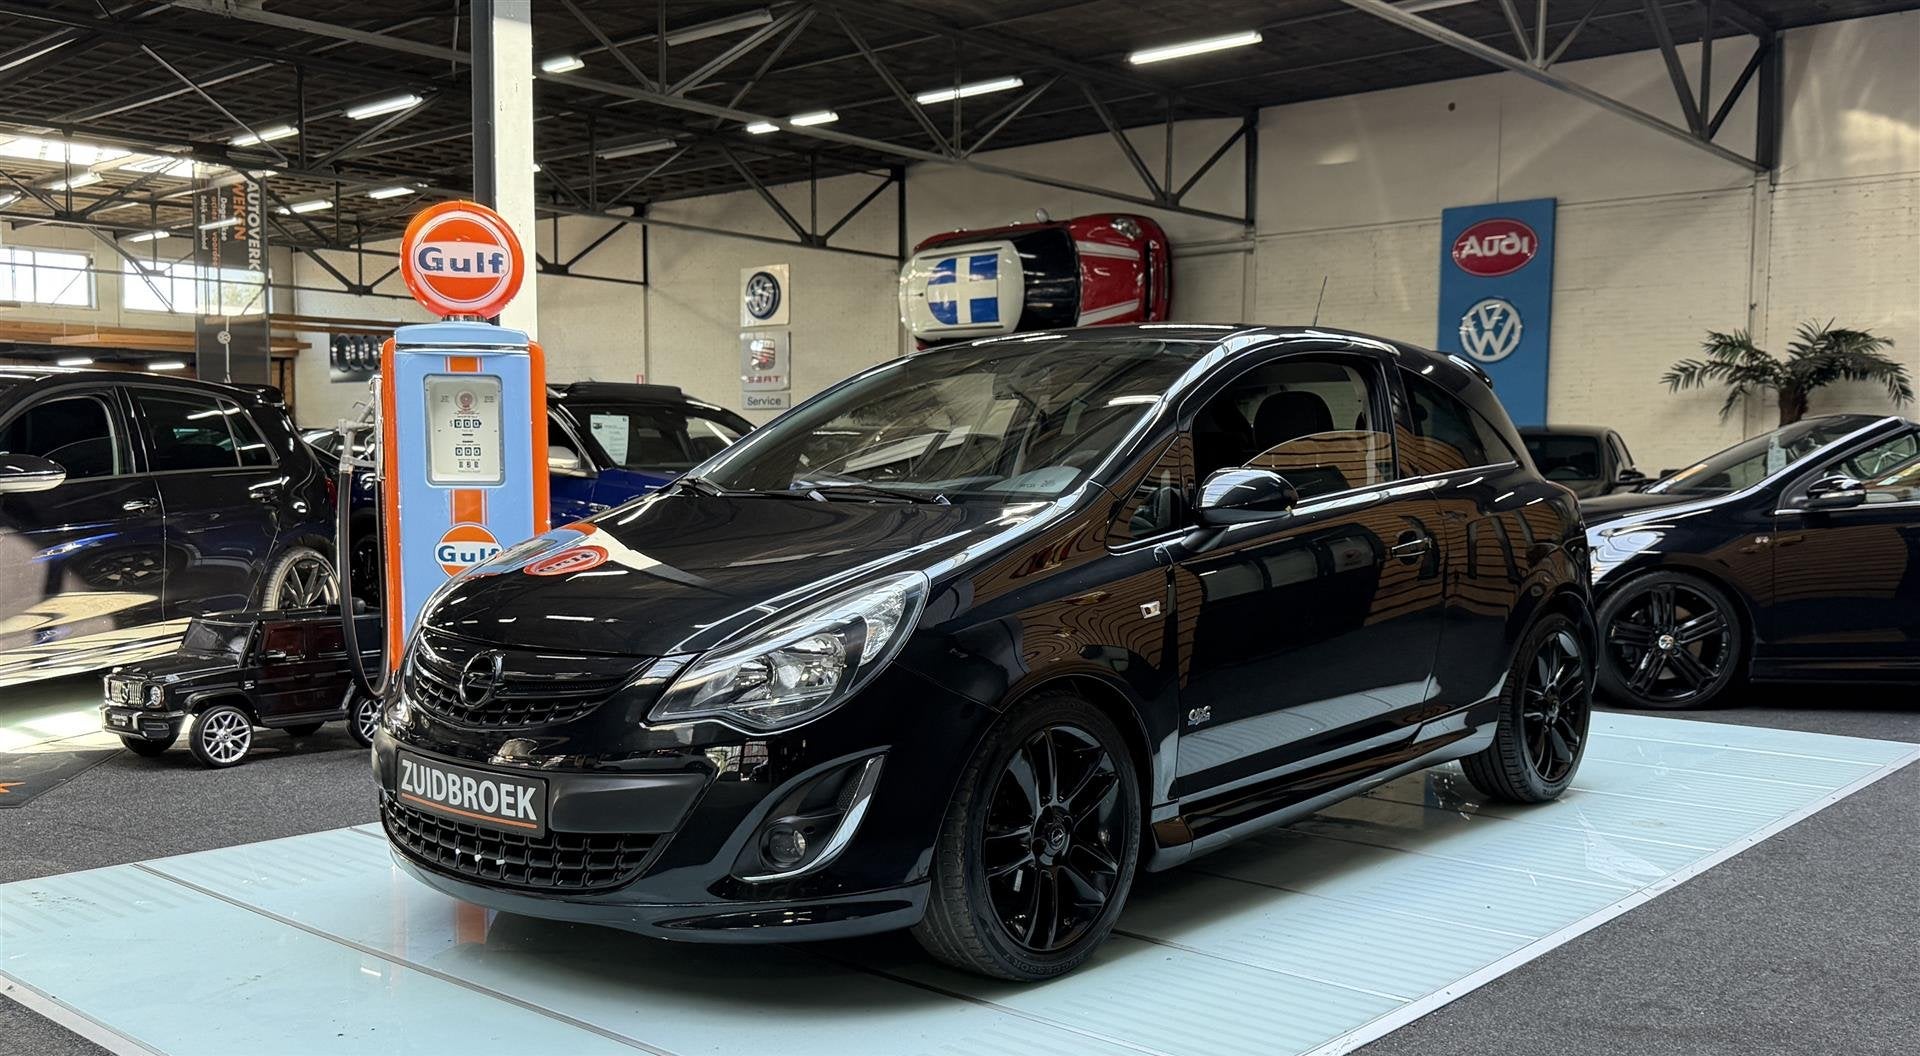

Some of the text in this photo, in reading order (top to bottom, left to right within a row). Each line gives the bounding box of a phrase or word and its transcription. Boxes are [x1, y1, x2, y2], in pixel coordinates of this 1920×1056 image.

[418, 246, 505, 274] Gulf
[746, 395, 782, 406] Service
[401, 759, 538, 821] ZUIDBROEK
